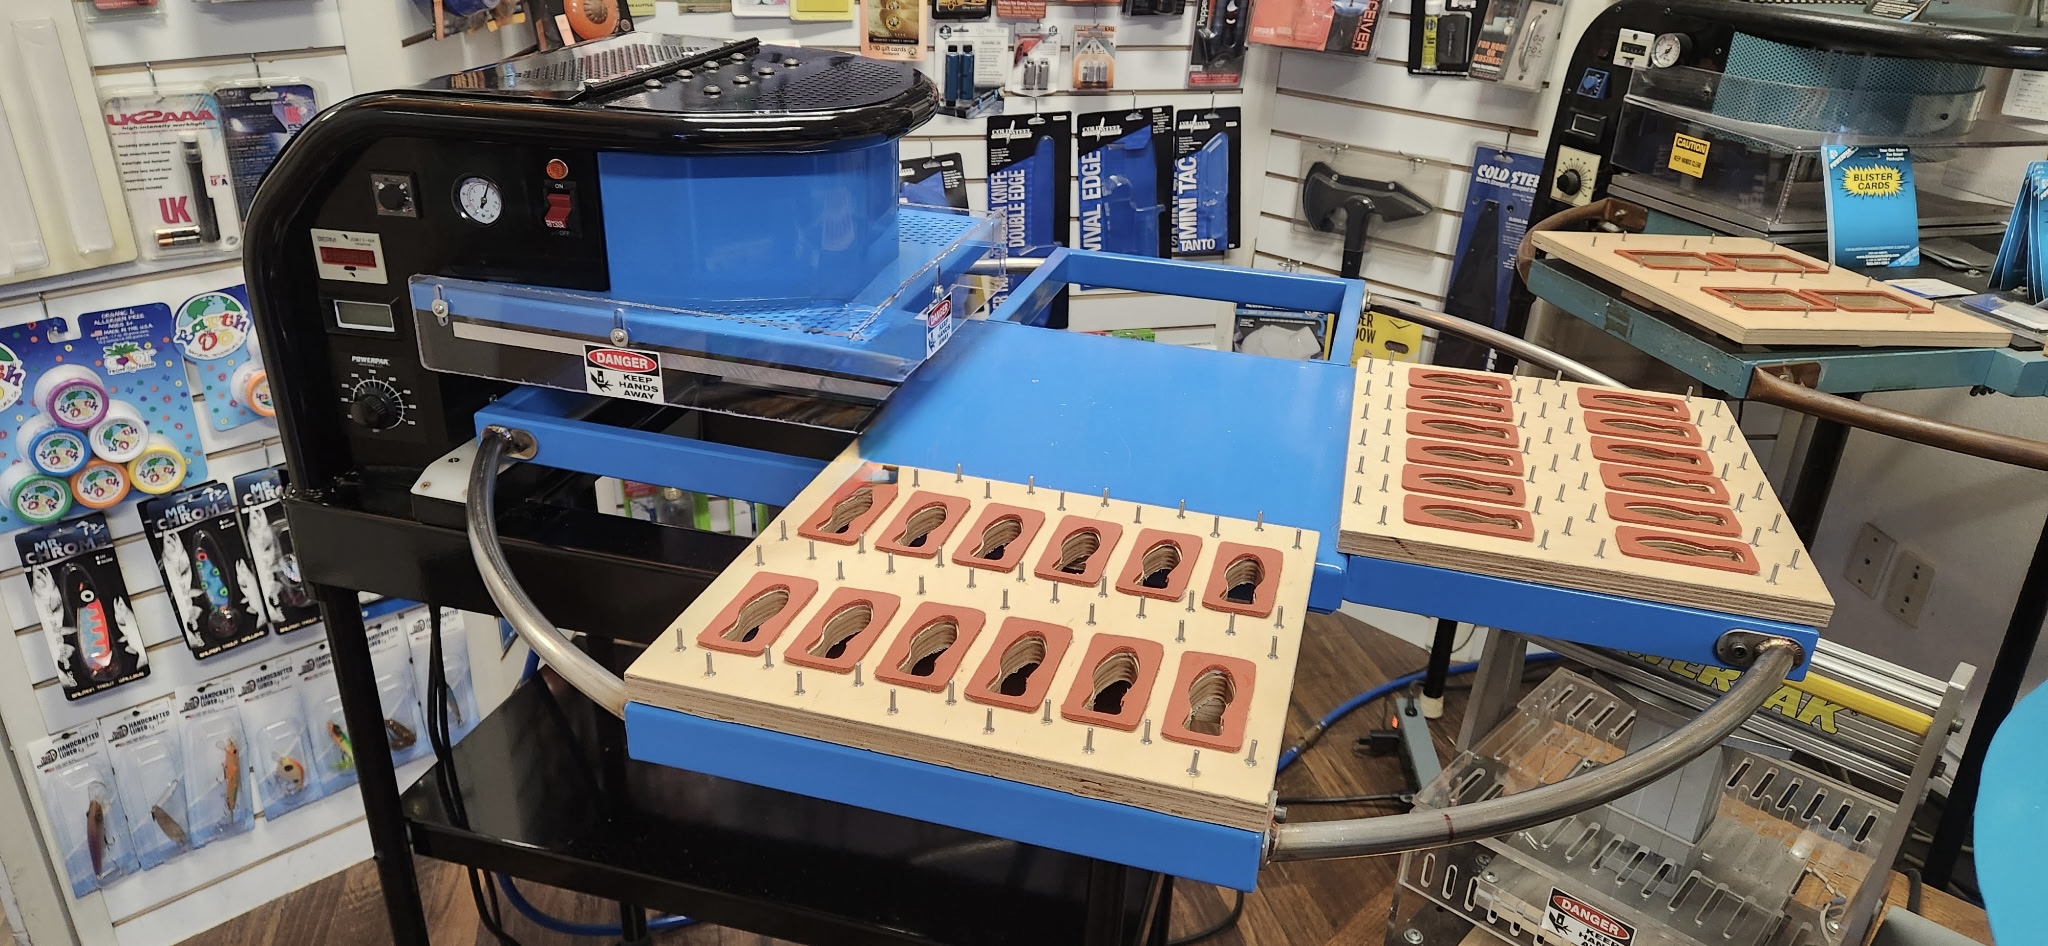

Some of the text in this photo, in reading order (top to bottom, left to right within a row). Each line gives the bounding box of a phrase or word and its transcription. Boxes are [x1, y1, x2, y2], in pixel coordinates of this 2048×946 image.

[1355, 0, 1380, 51] CEIVER
[107, 110, 216, 126] UK2AAA
[1677, 138, 1706, 154] CAUTION
[1081, 150, 1102, 201] EDGE
[1178, 156, 1197, 194] TAC
[1477, 164, 1510, 182] COLD
[1853, 173, 1893, 182] BLISTER
[991, 171, 1008, 204] KNIFE
[1858, 182, 1890, 190] CARDS
[159, 196, 193, 225] UK
[1008, 169, 1025, 248] DOUBLE EDGE
[1179, 197, 1197, 241] MINI
[1180, 239, 1216, 252] TANTO
[596, 352, 649, 369] DANGER
[619, 381, 659, 393] HANDS
[623, 374, 653, 384] KEEP
[623, 390, 655, 400] AWAY
[250, 480, 275, 495] MR.
[156, 502, 230, 530] CHROME
[165, 503, 191, 519] MR.
[25, 535, 107, 564] CHROME
[34, 537, 63, 552] MR.
[128, 709, 170, 729] HANDCRAFTED
[57, 731, 100, 753] HANDCRAFTED
[1561, 898, 1619, 936] DANGER
